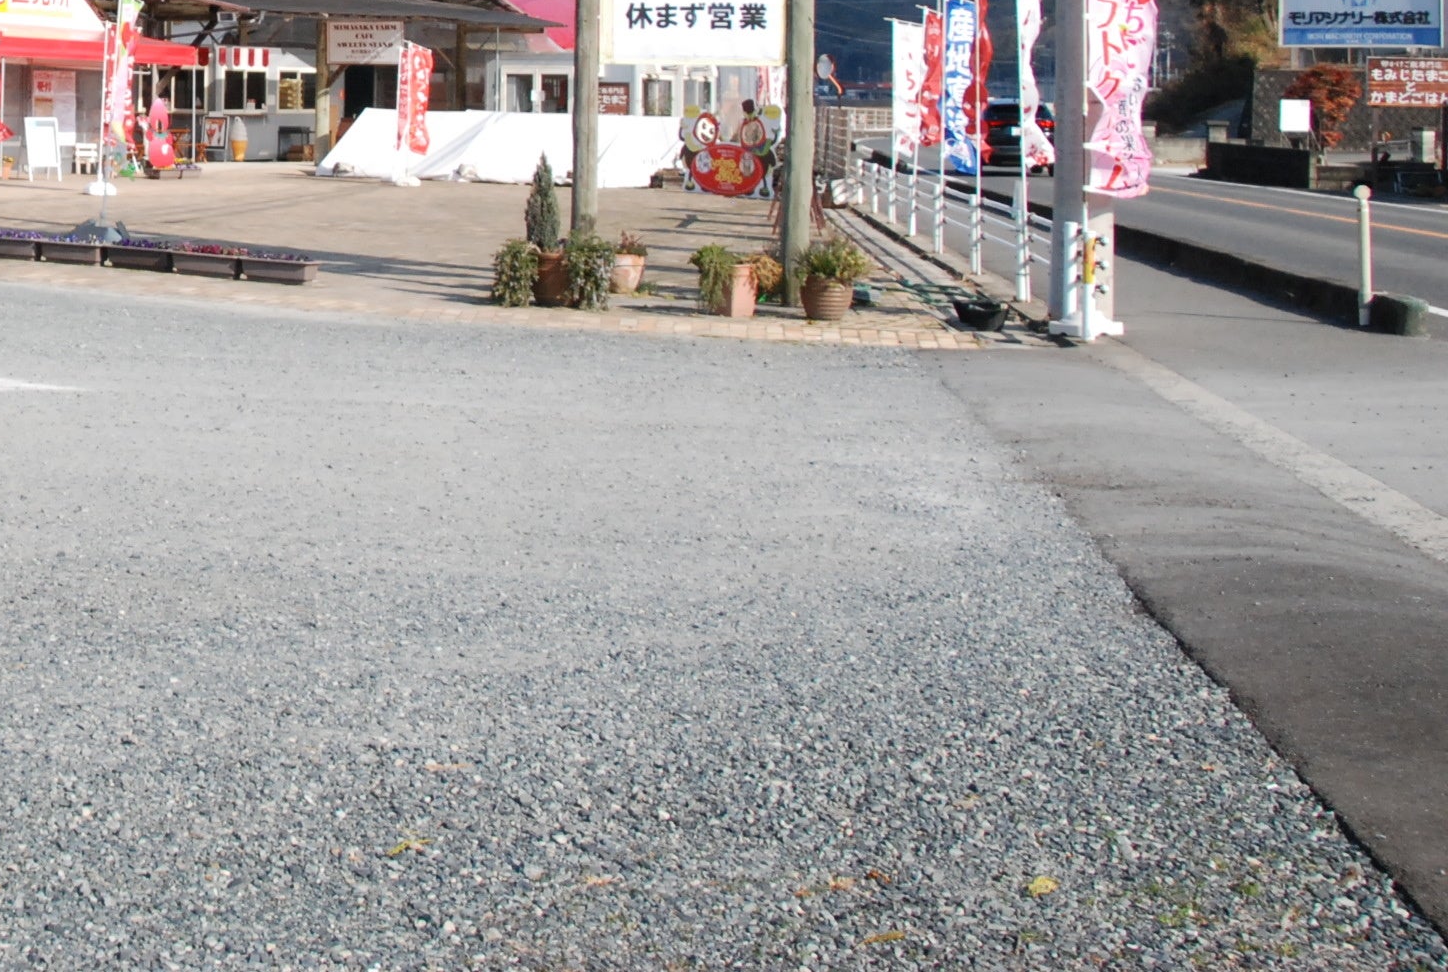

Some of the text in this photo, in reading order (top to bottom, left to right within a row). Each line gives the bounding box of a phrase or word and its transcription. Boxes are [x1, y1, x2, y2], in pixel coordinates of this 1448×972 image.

[625, 2, 768, 31] 休まず営業
[1287, 10, 1432, 26] モリマシナリー株式会社
